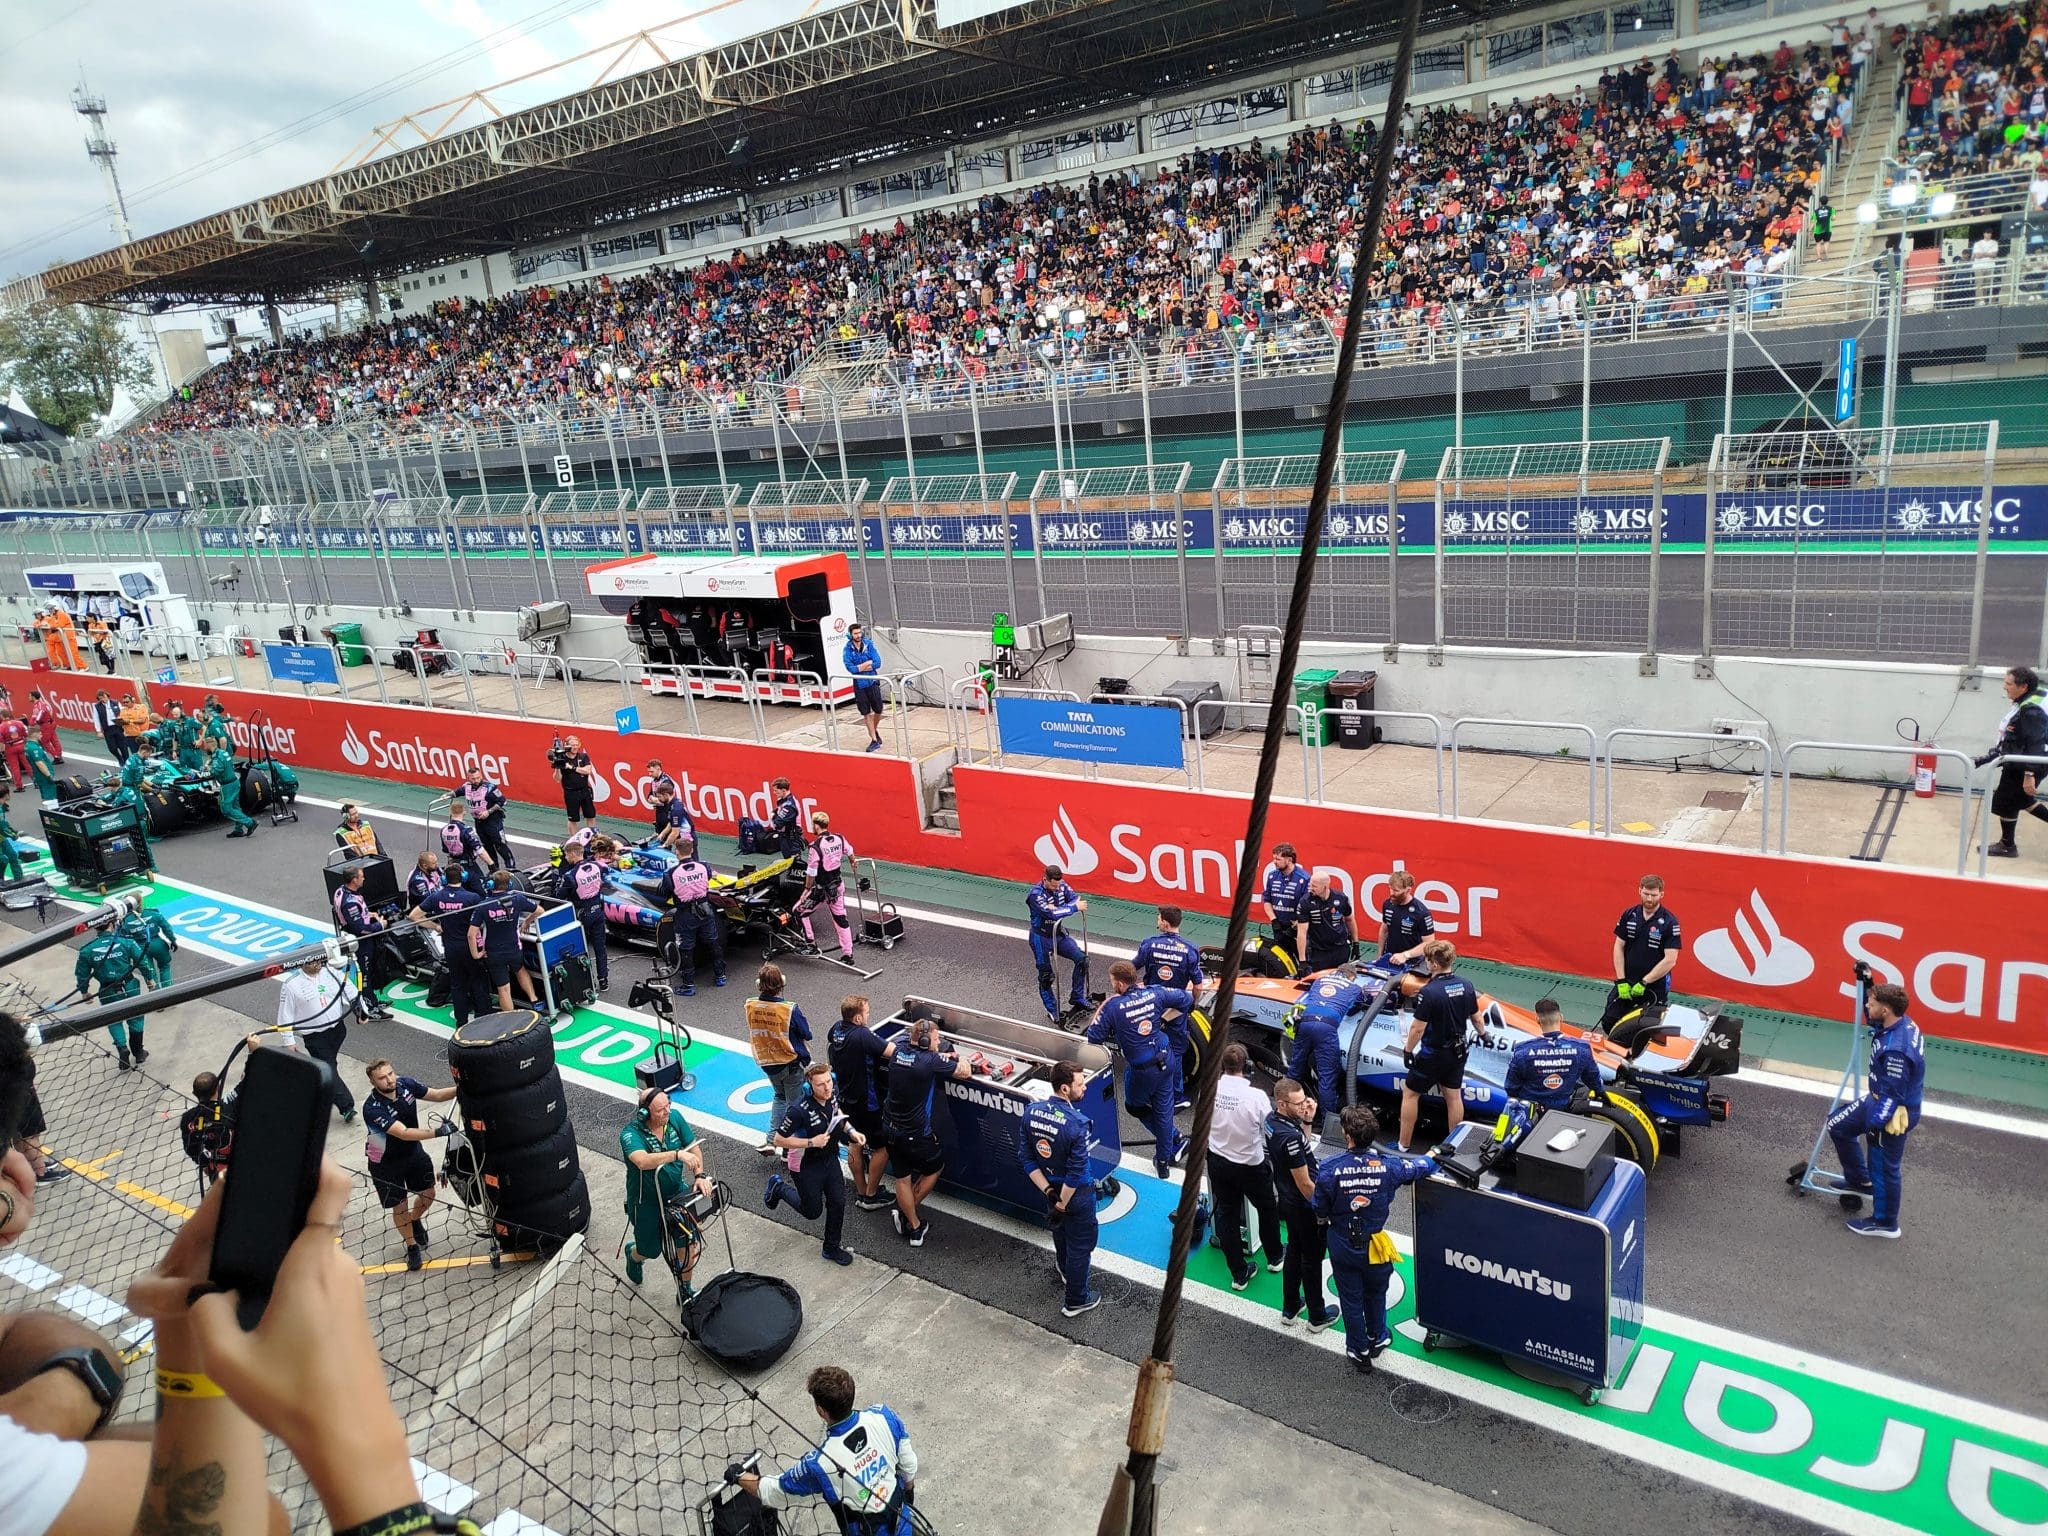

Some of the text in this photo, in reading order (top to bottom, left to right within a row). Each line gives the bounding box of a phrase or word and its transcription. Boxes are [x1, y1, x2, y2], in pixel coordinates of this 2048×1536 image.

[1841, 342, 1851, 414] 100
[557, 459, 572, 483] 50
[1605, 508, 1669, 529] MSC
[1754, 504, 1826, 527] MSC
[1938, 498, 2021, 524] MSC
[1152, 520, 1194, 538] MSC
[1248, 517, 1295, 536] MSC
[1355, 515, 1405, 534] MSC
[1472, 511, 1530, 531] MSC
[434, 532, 453, 543] MC
[476, 532, 495, 543] MSC
[517, 531, 539, 543] MC
[563, 531, 585, 543] MSC
[611, 530, 636, 543] MC
[664, 529, 689, 542] MSC
[719, 528, 746, 541] MC
[777, 527, 806, 541] MSC
[909, 525, 942, 540] MSC
[983, 524, 1018, 540] MSC
[1063, 522, 1102, 539] MSC
[49, 690, 95, 723] Santa
[617, 716, 630, 728] W
[1067, 711, 1094, 723] TATA
[1040, 721, 1126, 737] COMMUNICATIONS
[1053, 741, 1118, 753] #EmpoweringTomorrow
[368, 730, 510, 787] Santander
[649, 860, 666, 870] eni
[587, 872, 600, 883] BWT
[687, 872, 704, 882] BWT
[446, 902, 464, 910] BWT
[603, 901, 642, 925] WT
[1153, 951, 1183, 962] KOMATSU
[1156, 943, 1189, 954] ATLASSIAN
[283, 952, 327, 970] MoneyGram
[1260, 1005, 1283, 1021] Steph
[1580, 1031, 1604, 1043] 23
[1536, 1048, 1577, 1056] ATLASSIAN
[1533, 1057, 1573, 1067] KOMATSU
[1634, 1076, 1699, 1094] KOMATSU
[944, 1080, 1026, 1117] KOMATSU
[1669, 1093, 1702, 1109] brillio
[1034, 1109, 1068, 1126] ATLASSIAN
[1030, 1119, 1059, 1136] KOMATSU
[1342, 1165, 1387, 1175] ATLASSIAN
[1340, 1177, 1382, 1187] KOMATSU
[1444, 1248, 1573, 1302] KOMATSU
[1524, 1346, 1596, 1373] WILLIAMS RACING
[1534, 1341, 1596, 1367] ATLASSIAN
[854, 1449, 878, 1472] HUGO
[855, 1454, 888, 1487] VISA
